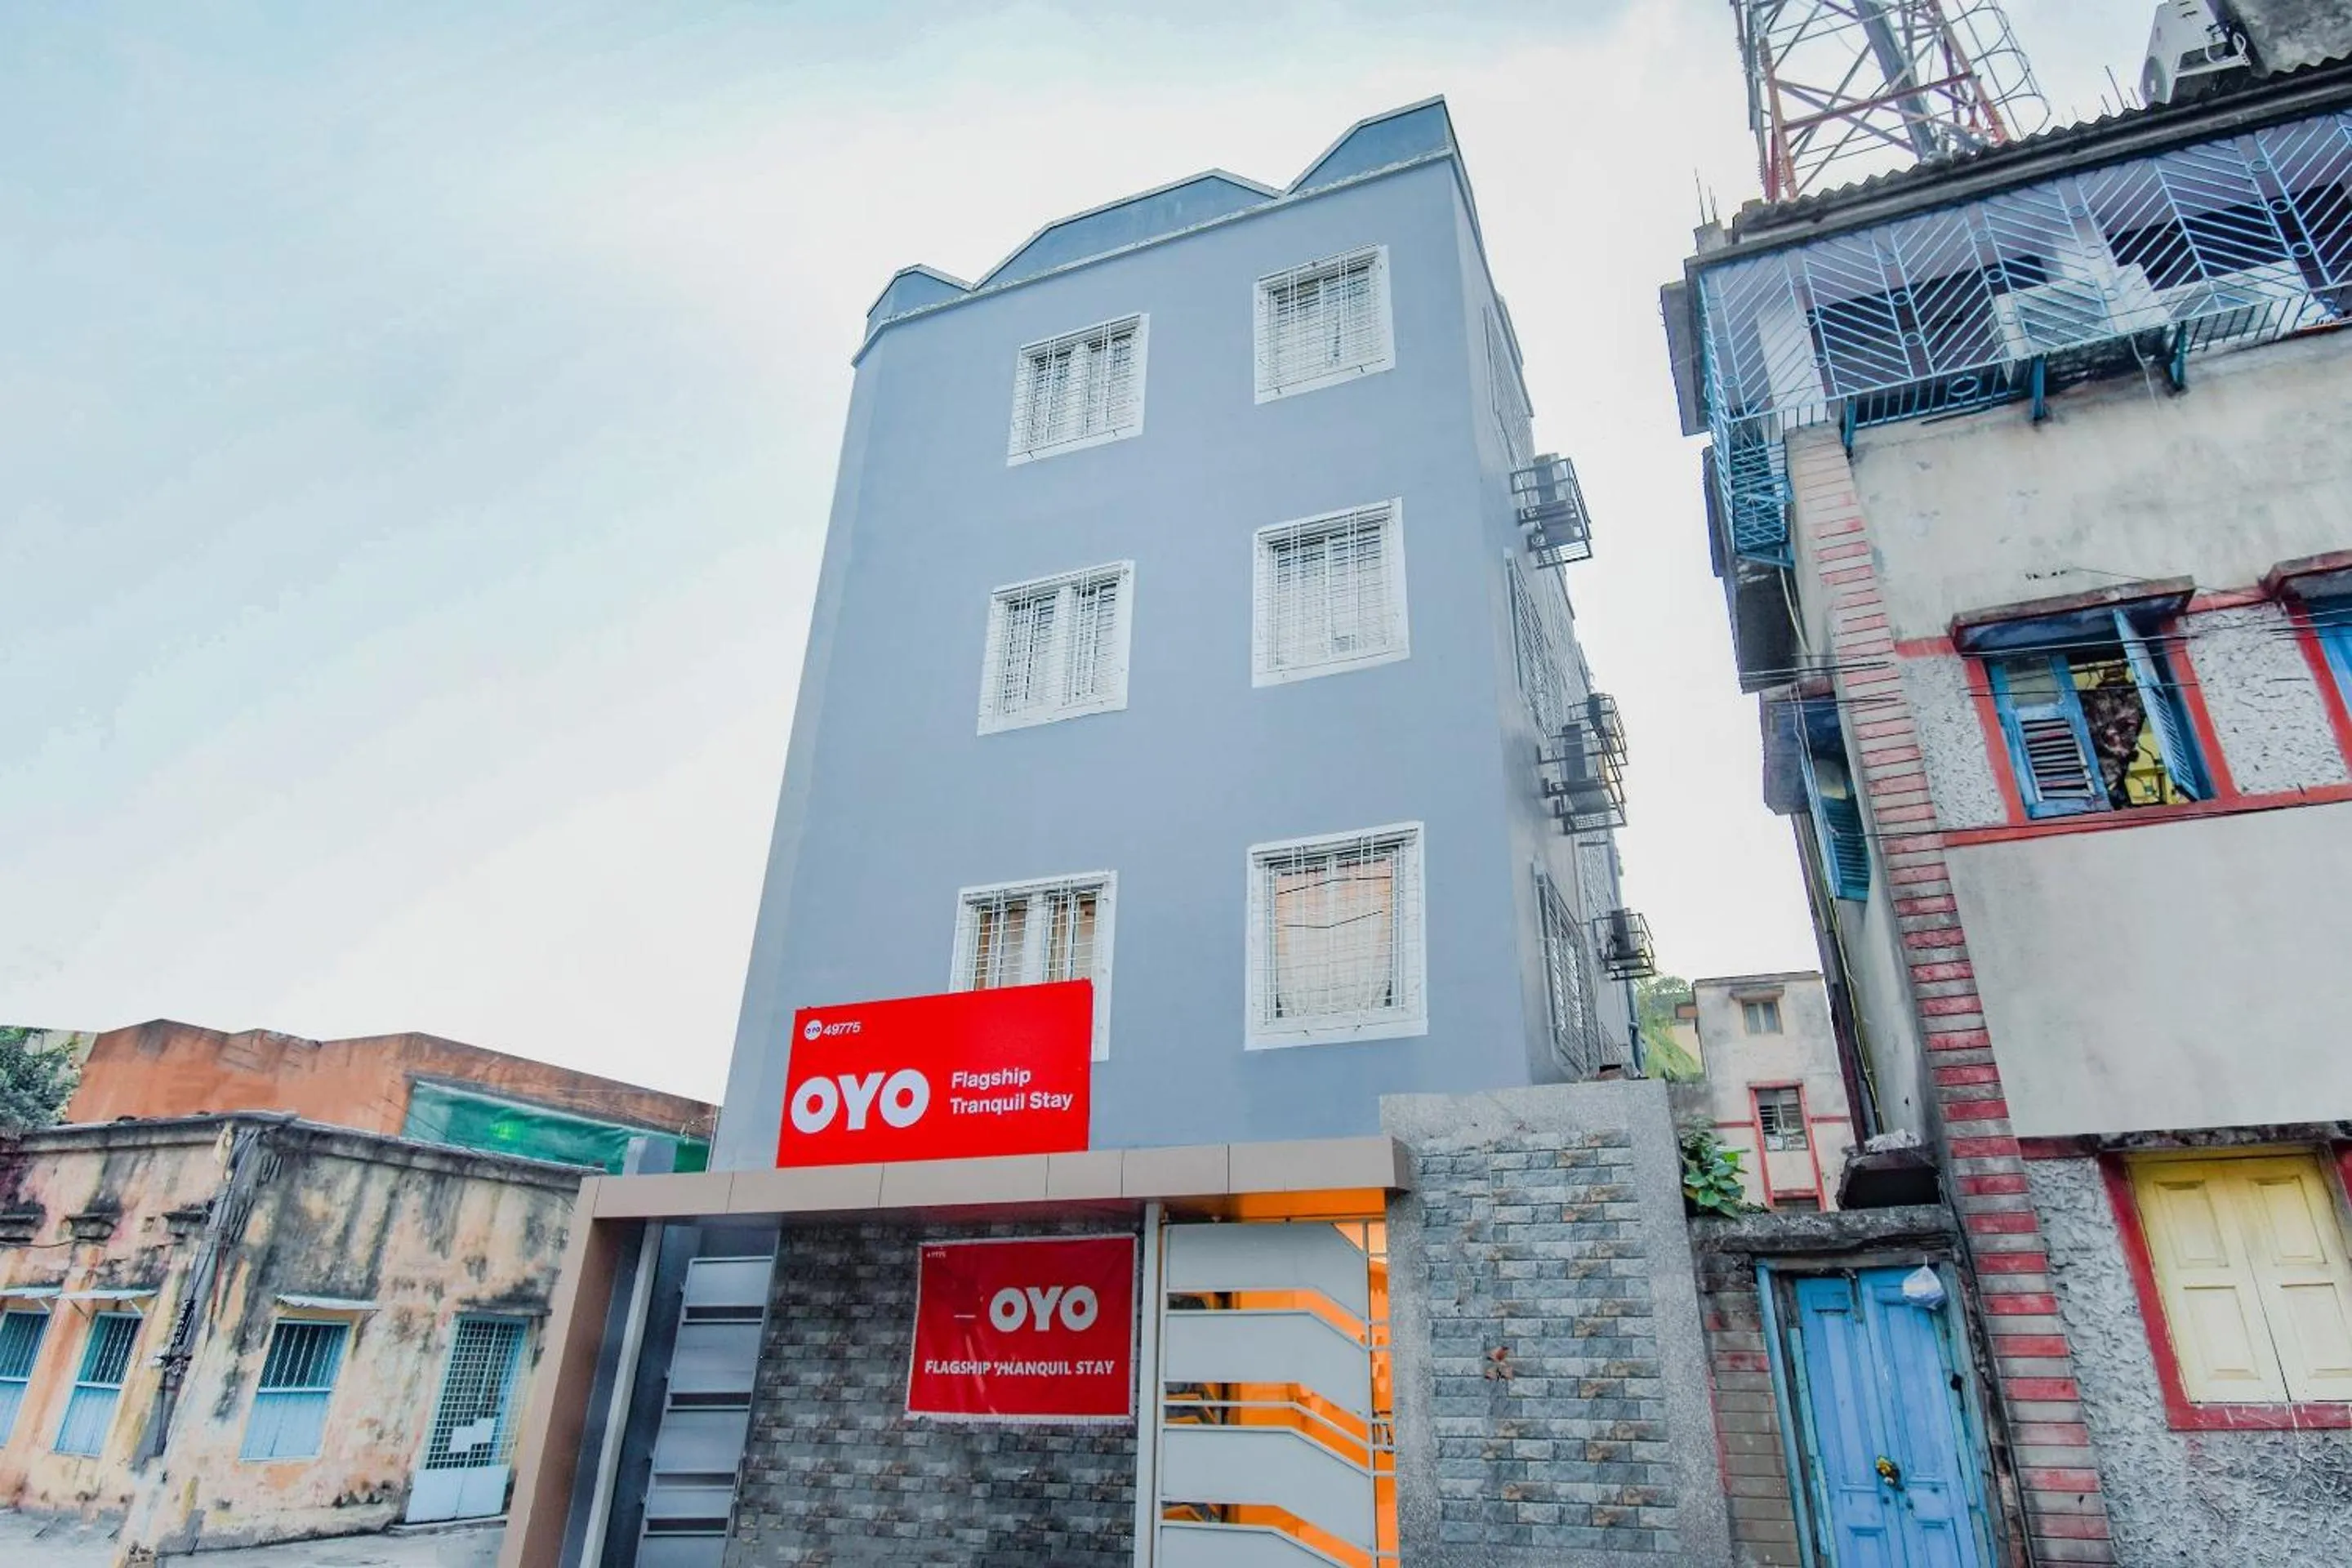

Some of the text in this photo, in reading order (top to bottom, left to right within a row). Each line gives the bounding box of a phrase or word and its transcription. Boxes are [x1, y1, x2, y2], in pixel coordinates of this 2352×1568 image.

[823, 1022, 862, 1036] 49775
[951, 1067, 1031, 1090] Flagship
[791, 1068, 931, 1134] OYO
[950, 1091, 1074, 1116] Tranquil Stay
[989, 1285, 1098, 1333] OYO
[924, 1360, 991, 1375] FLAGSHIP
[1076, 1361, 1115, 1375] STAY
